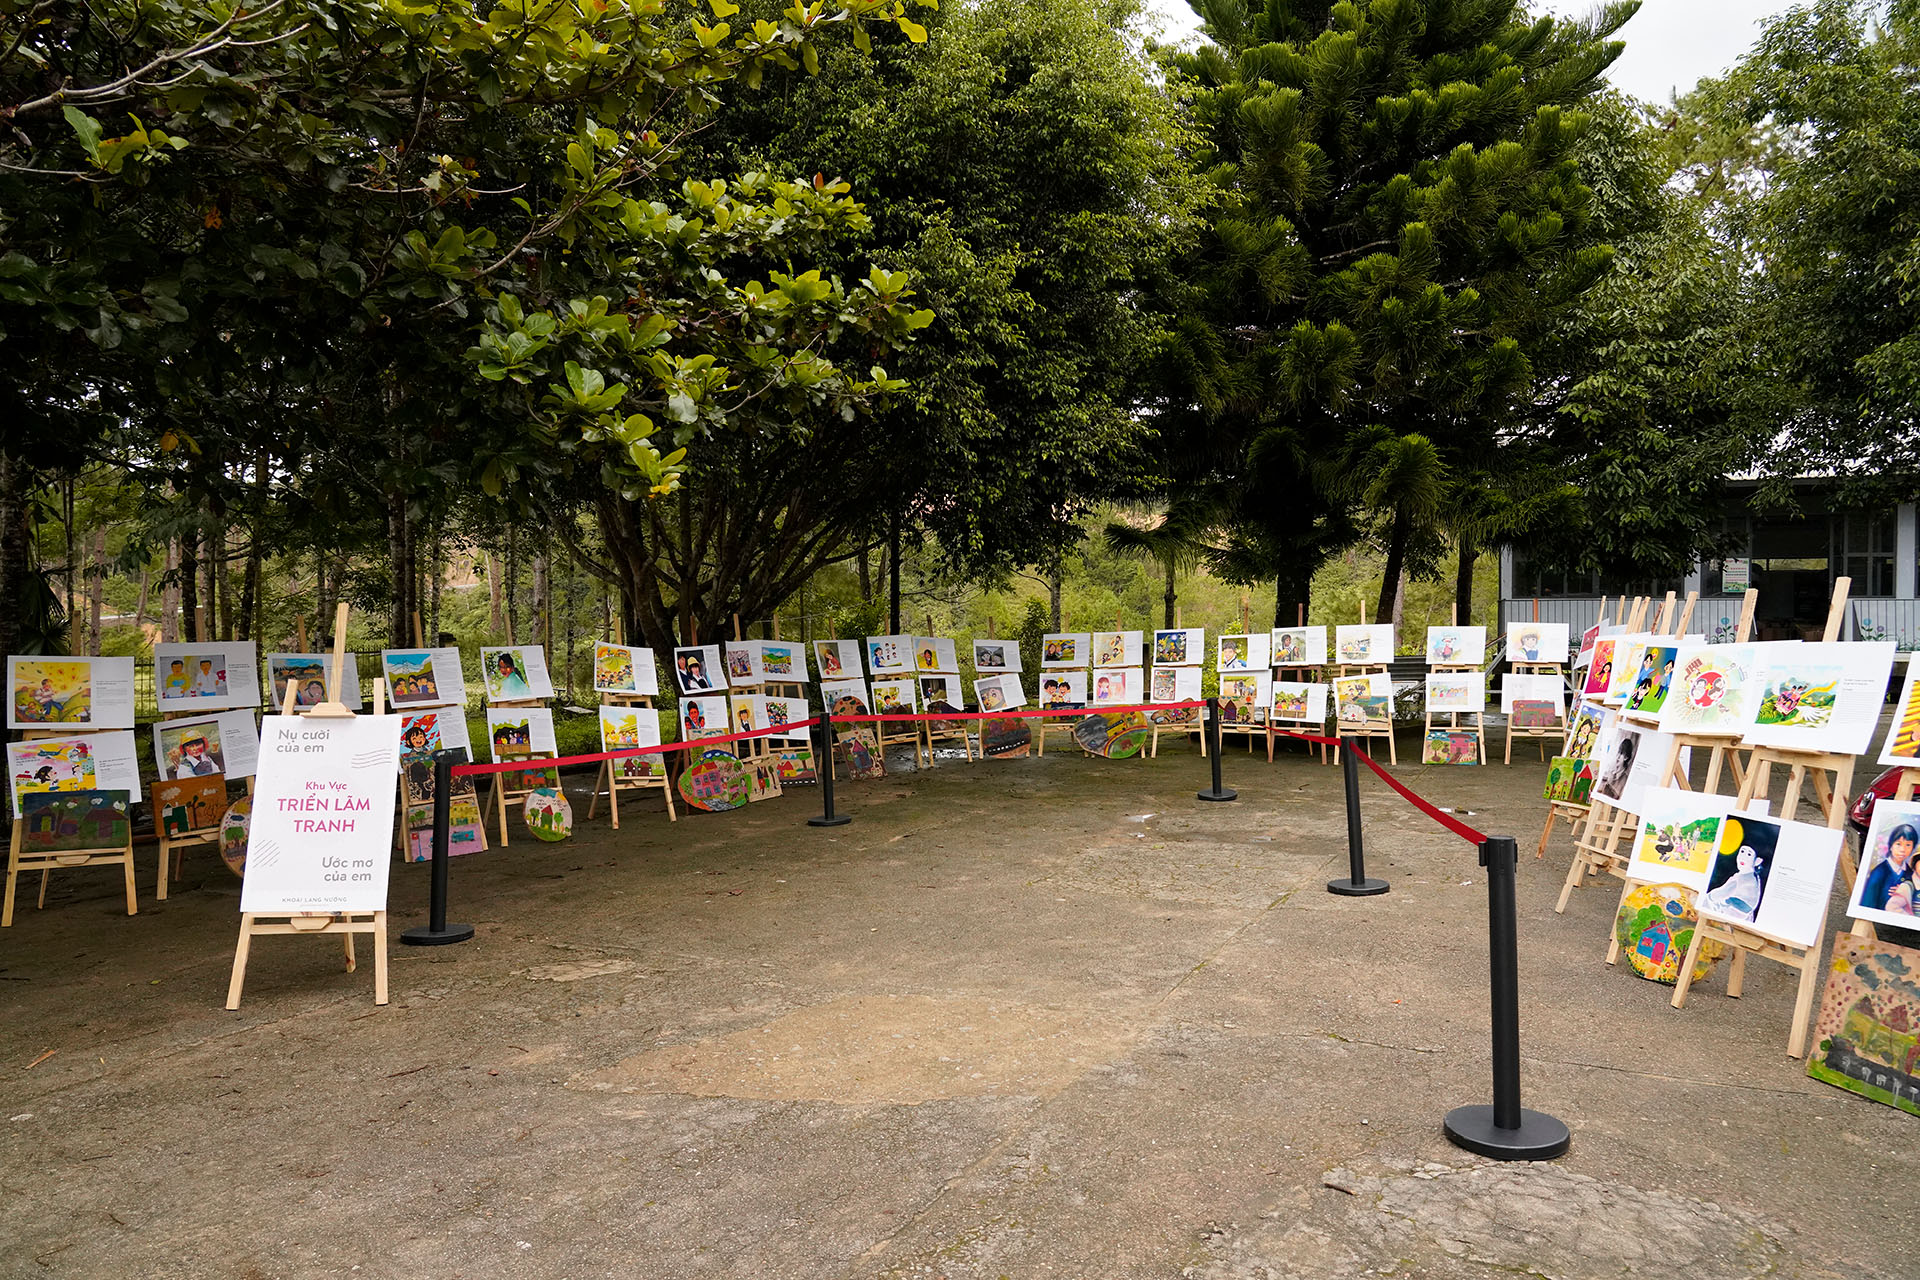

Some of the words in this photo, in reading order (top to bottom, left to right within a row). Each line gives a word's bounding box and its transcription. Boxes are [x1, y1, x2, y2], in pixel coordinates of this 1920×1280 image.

[278, 729, 298, 743] Nụ
[302, 729, 330, 740] cười
[276, 742, 300, 752] của
[304, 744, 325, 752] em
[305, 781, 326, 790] Khu
[328, 781, 348, 792] Vực
[277, 793, 329, 811] TRIỂN
[334, 795, 370, 811] LÃM
[293, 819, 355, 832] TRANH
[322, 856, 349, 868] Ước
[352, 859, 374, 868] mơ
[323, 871, 348, 881] của
[351, 873, 372, 881] em
